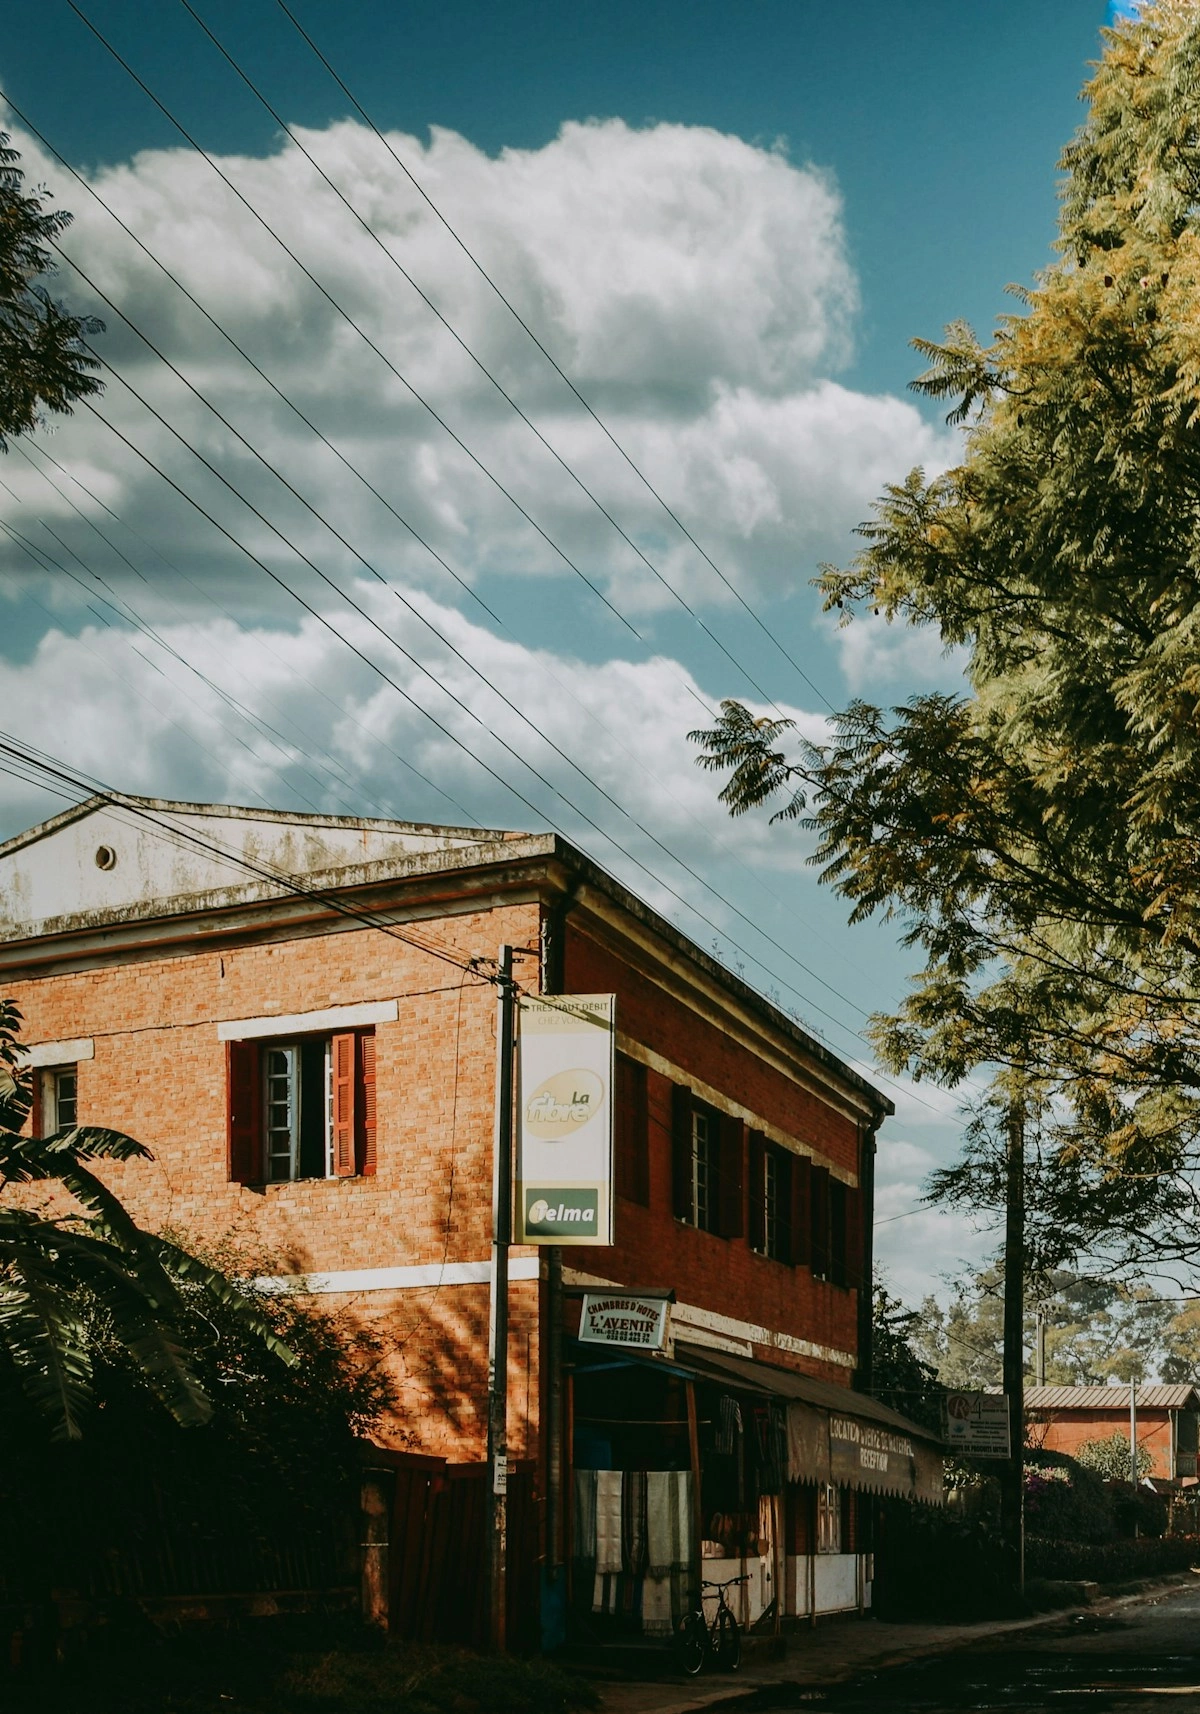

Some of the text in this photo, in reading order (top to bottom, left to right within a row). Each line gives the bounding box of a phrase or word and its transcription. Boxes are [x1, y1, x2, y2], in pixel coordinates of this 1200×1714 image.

[572, 1091, 590, 1105] La
[526, 1092, 591, 1123] fibre
[535, 1203, 595, 1222] Telma
[587, 1300, 630, 1315] CHAMBRES
[589, 1315, 655, 1333] L'AVENIR
